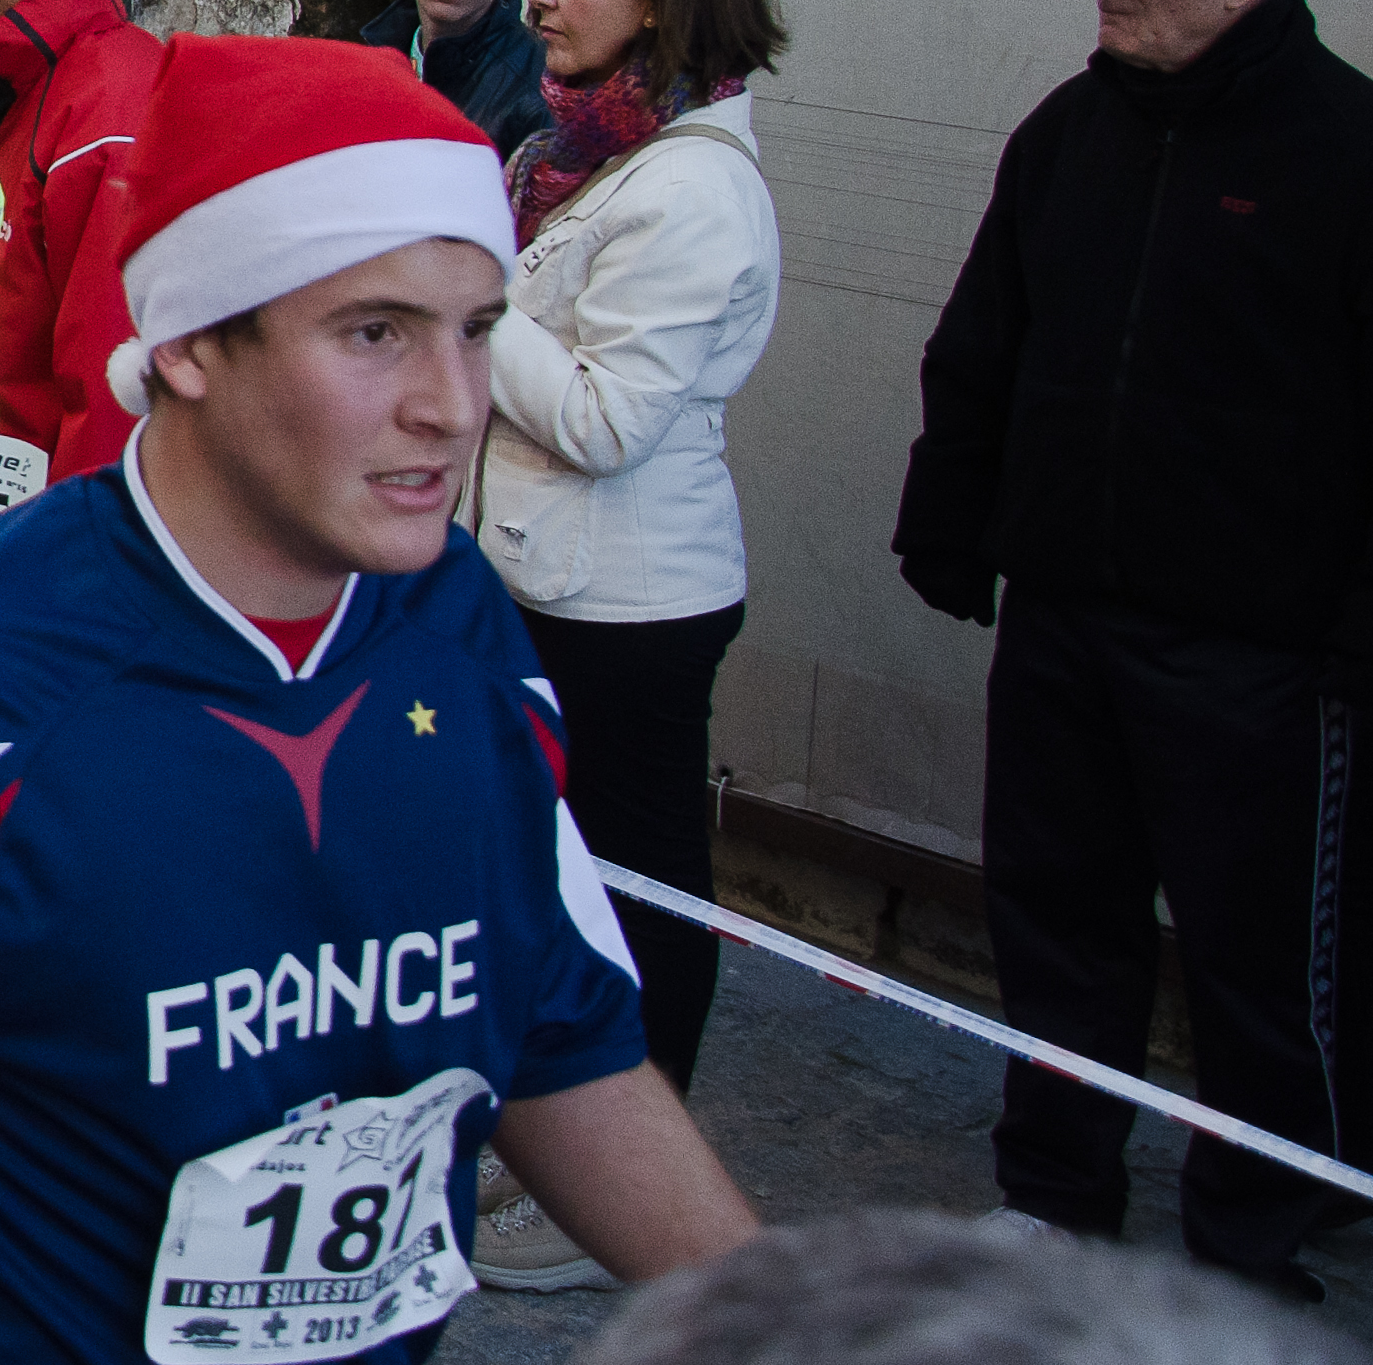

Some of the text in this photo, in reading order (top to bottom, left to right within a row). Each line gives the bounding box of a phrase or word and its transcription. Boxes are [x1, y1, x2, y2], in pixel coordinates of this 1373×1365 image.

[146, 919, 481, 1087] FRANCE
[208, 1281, 258, 1307] SAN
[304, 1314, 360, 1345] 2013
